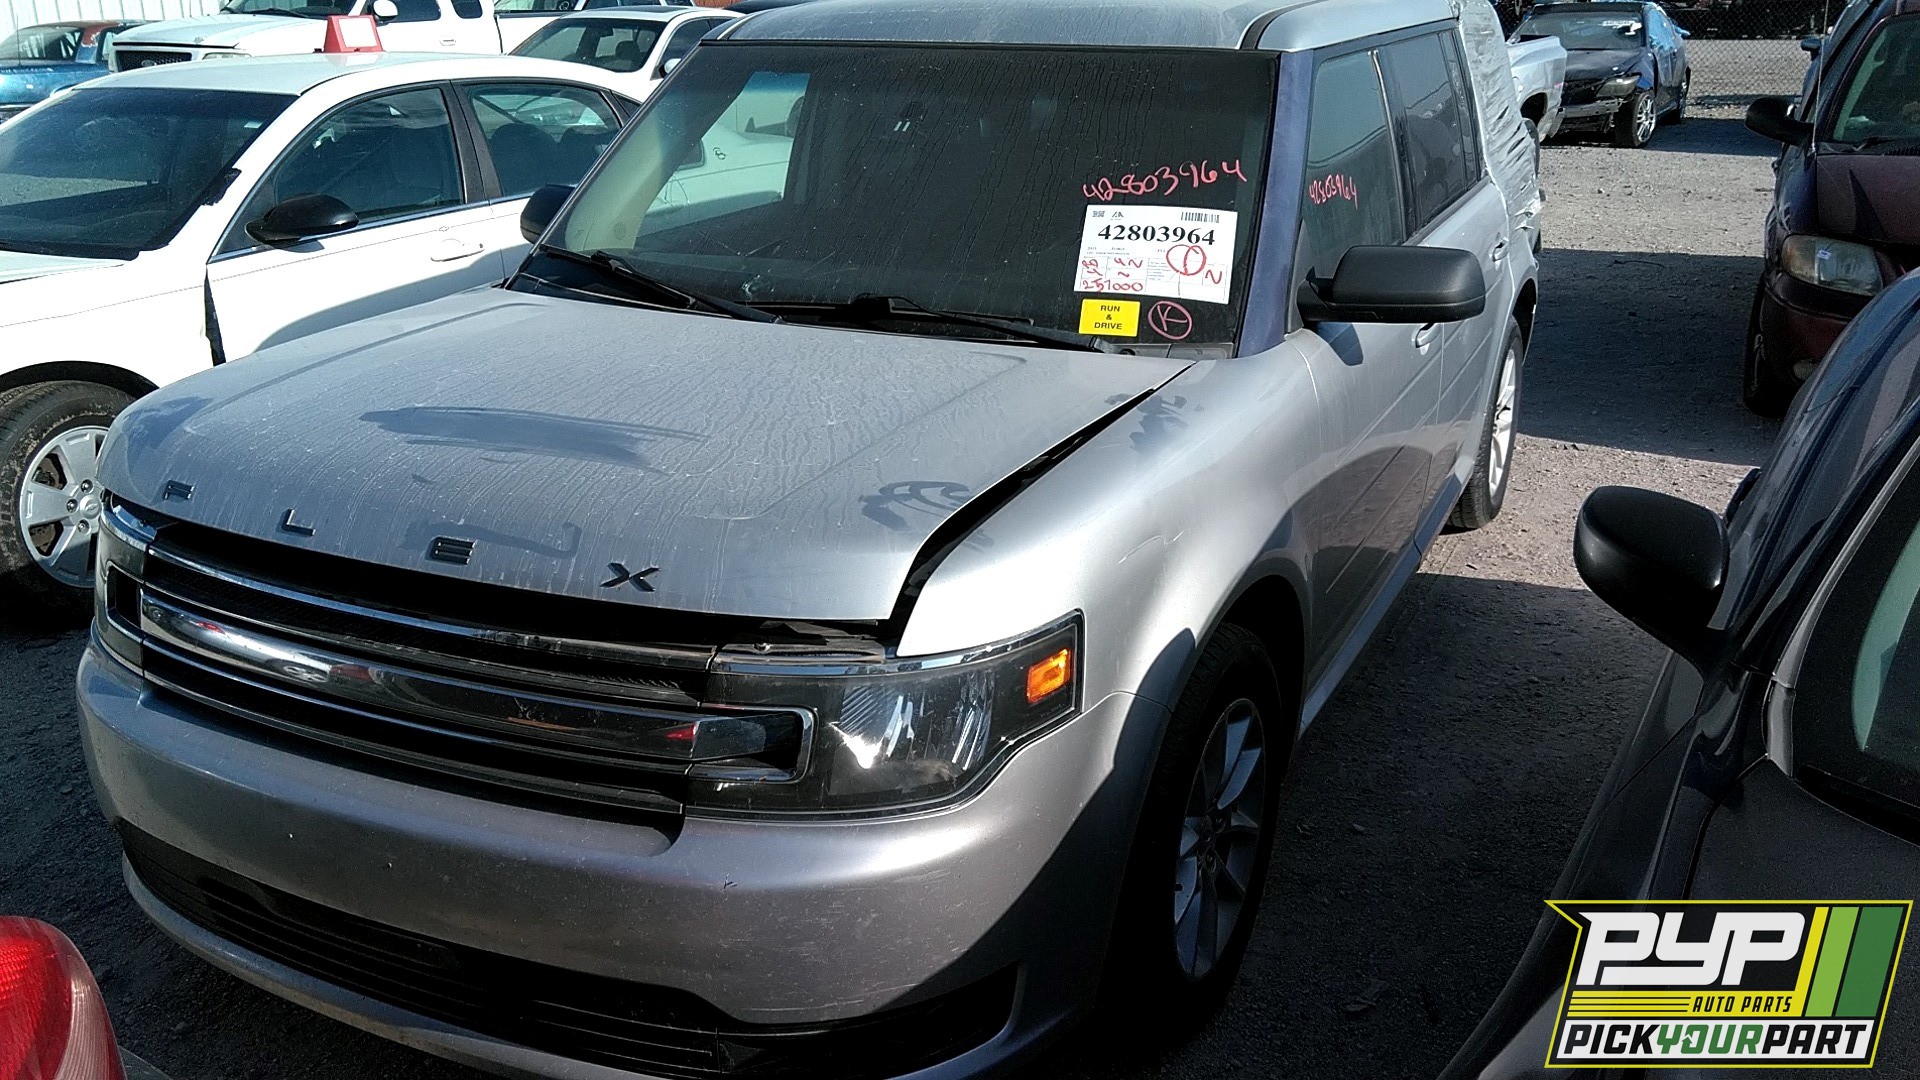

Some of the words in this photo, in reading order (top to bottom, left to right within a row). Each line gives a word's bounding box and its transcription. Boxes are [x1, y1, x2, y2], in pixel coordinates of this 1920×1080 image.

[1082, 159, 1247, 201] 42803964
[1309, 174, 1358, 210] 42803964
[1097, 224, 1216, 246] 42803964
[1100, 304, 1121, 313] RUN
[1093, 321, 1123, 331] DRIVE
[161, 478, 660, 592] FLEX
